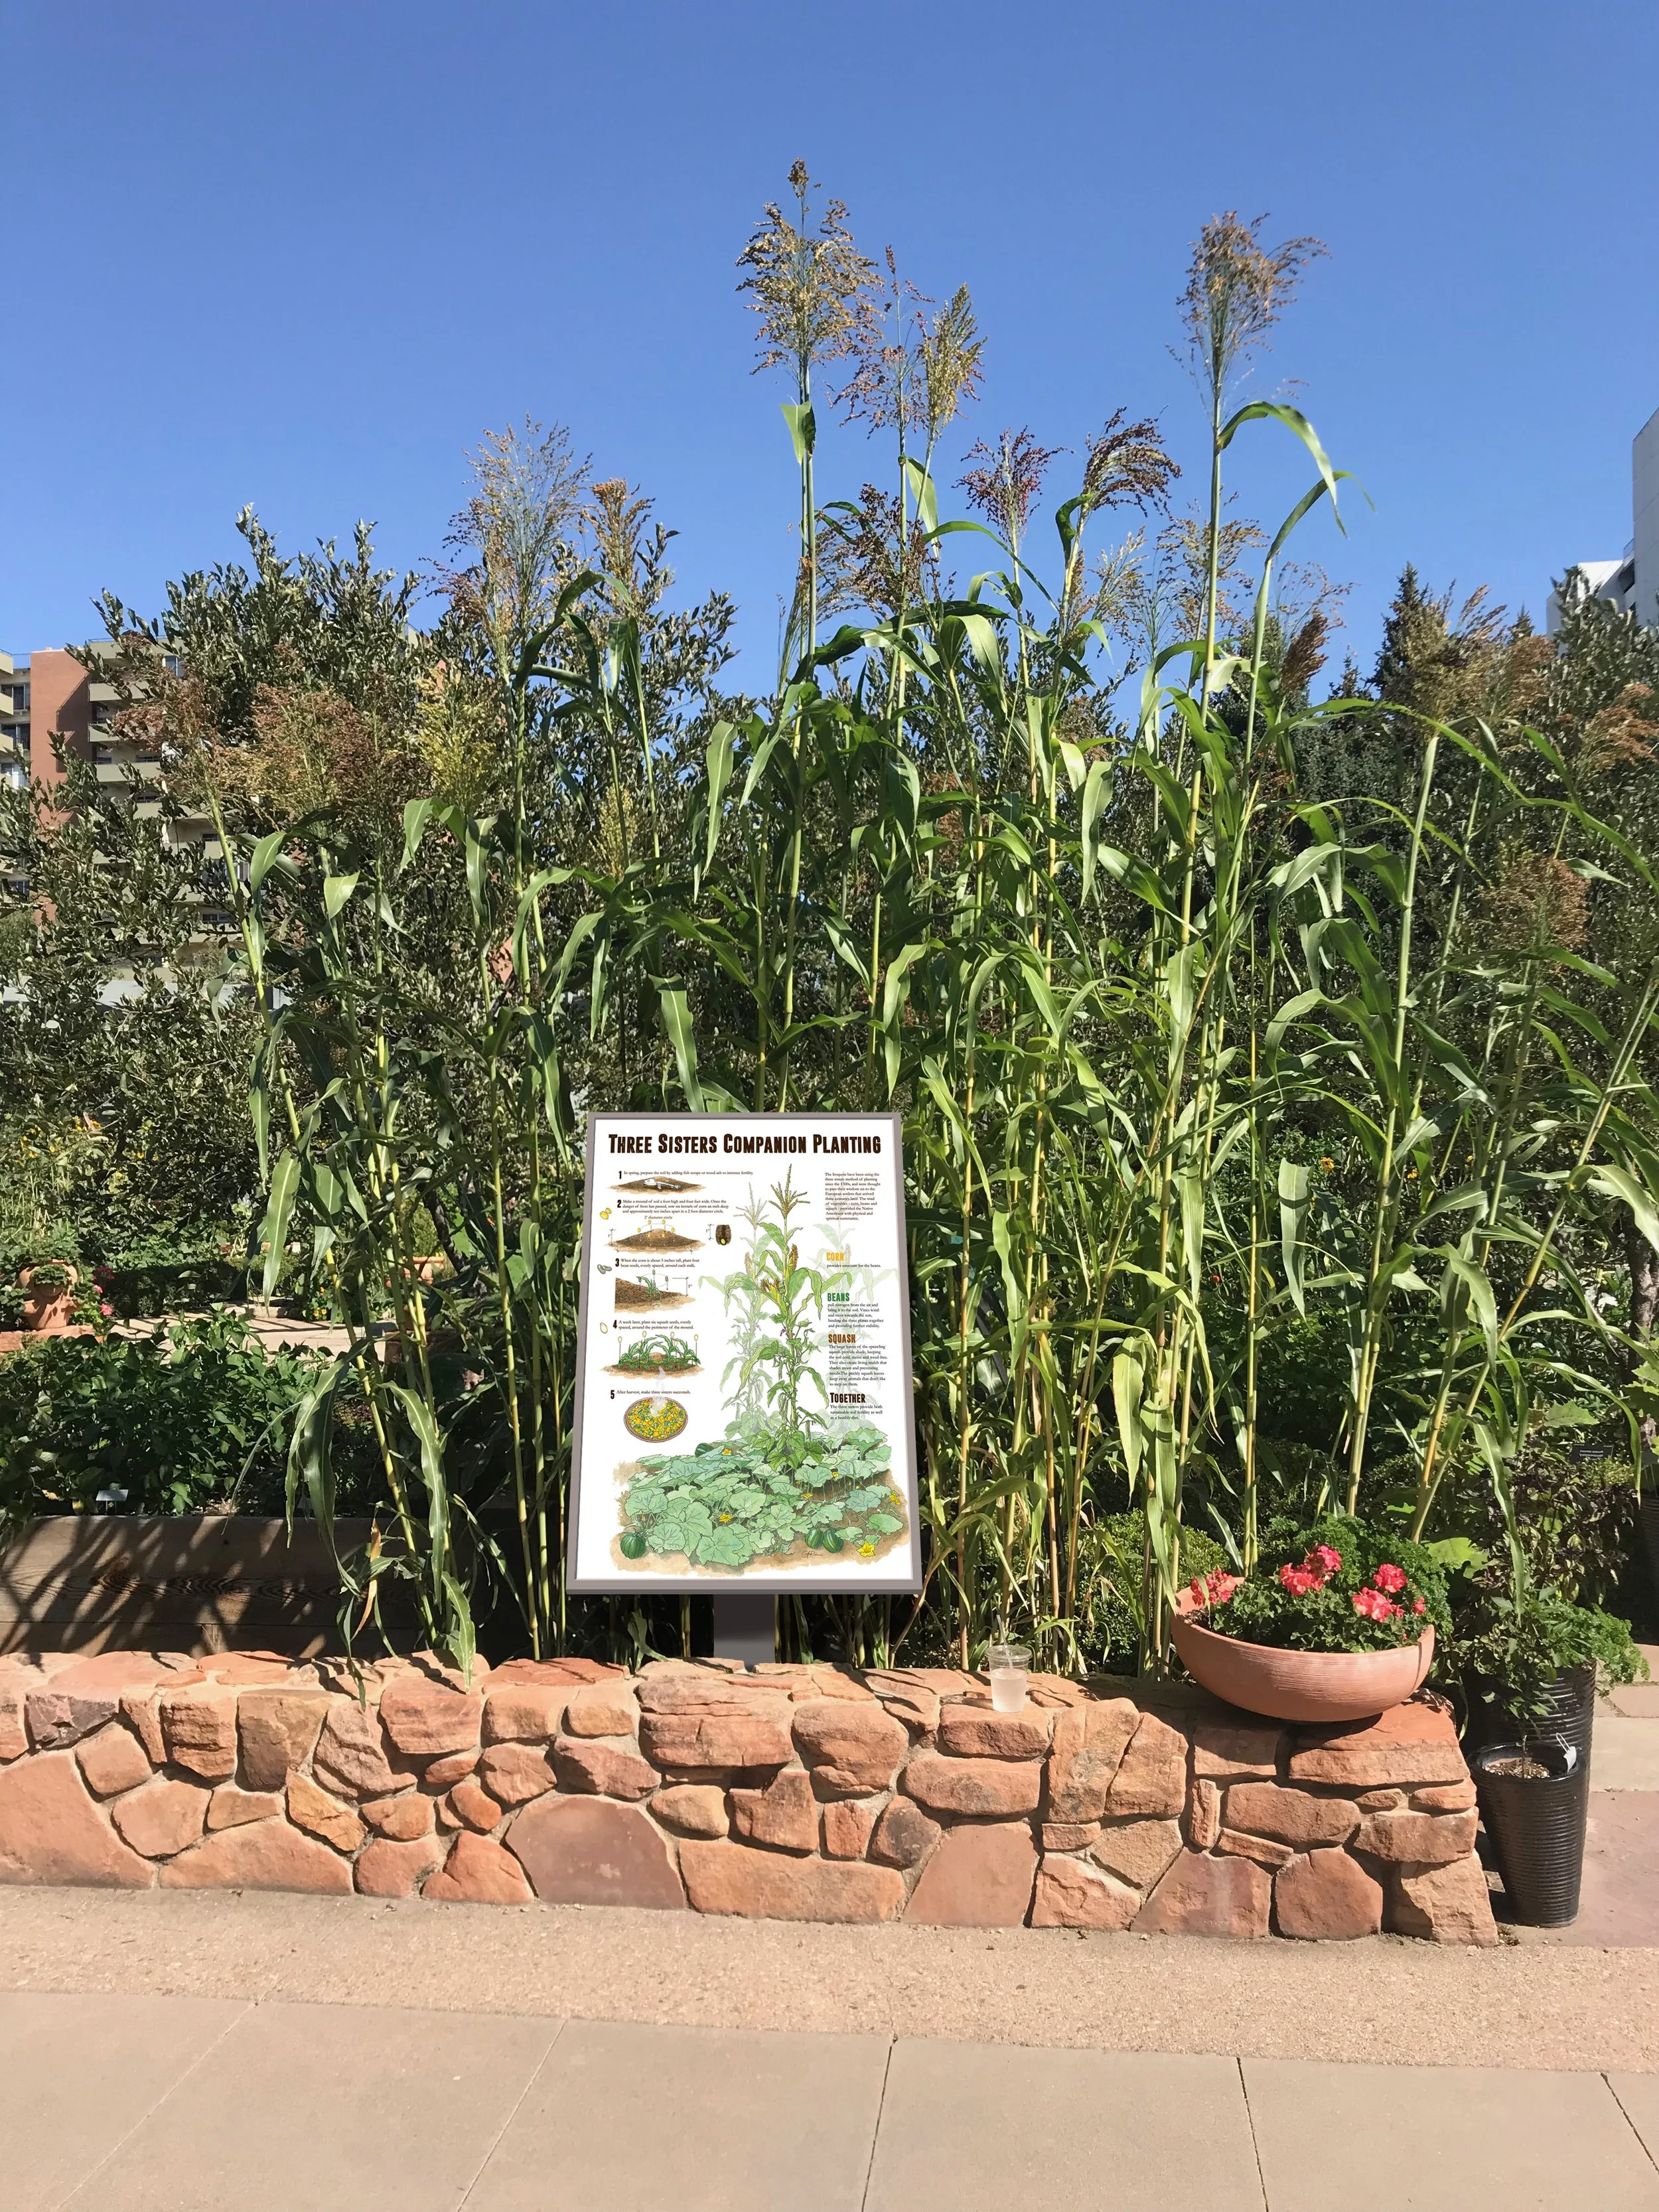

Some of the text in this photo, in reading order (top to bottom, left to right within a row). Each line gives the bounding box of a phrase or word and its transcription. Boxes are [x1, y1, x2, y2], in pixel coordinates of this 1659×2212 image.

[609, 1133, 881, 1154] THREE SISTERS COMPANION PLANTING
[618, 1171, 622, 1179] 1
[617, 1199, 621, 1208] 2
[827, 1252, 844, 1261] CORN
[614, 1258, 620, 1266] 3
[828, 1293, 849, 1301] BEANS
[613, 1319, 617, 1329] 4
[828, 1334, 855, 1344] SQUASH
[611, 1390, 614, 1399] 5
[830, 1392, 865, 1403] TOGETHER
